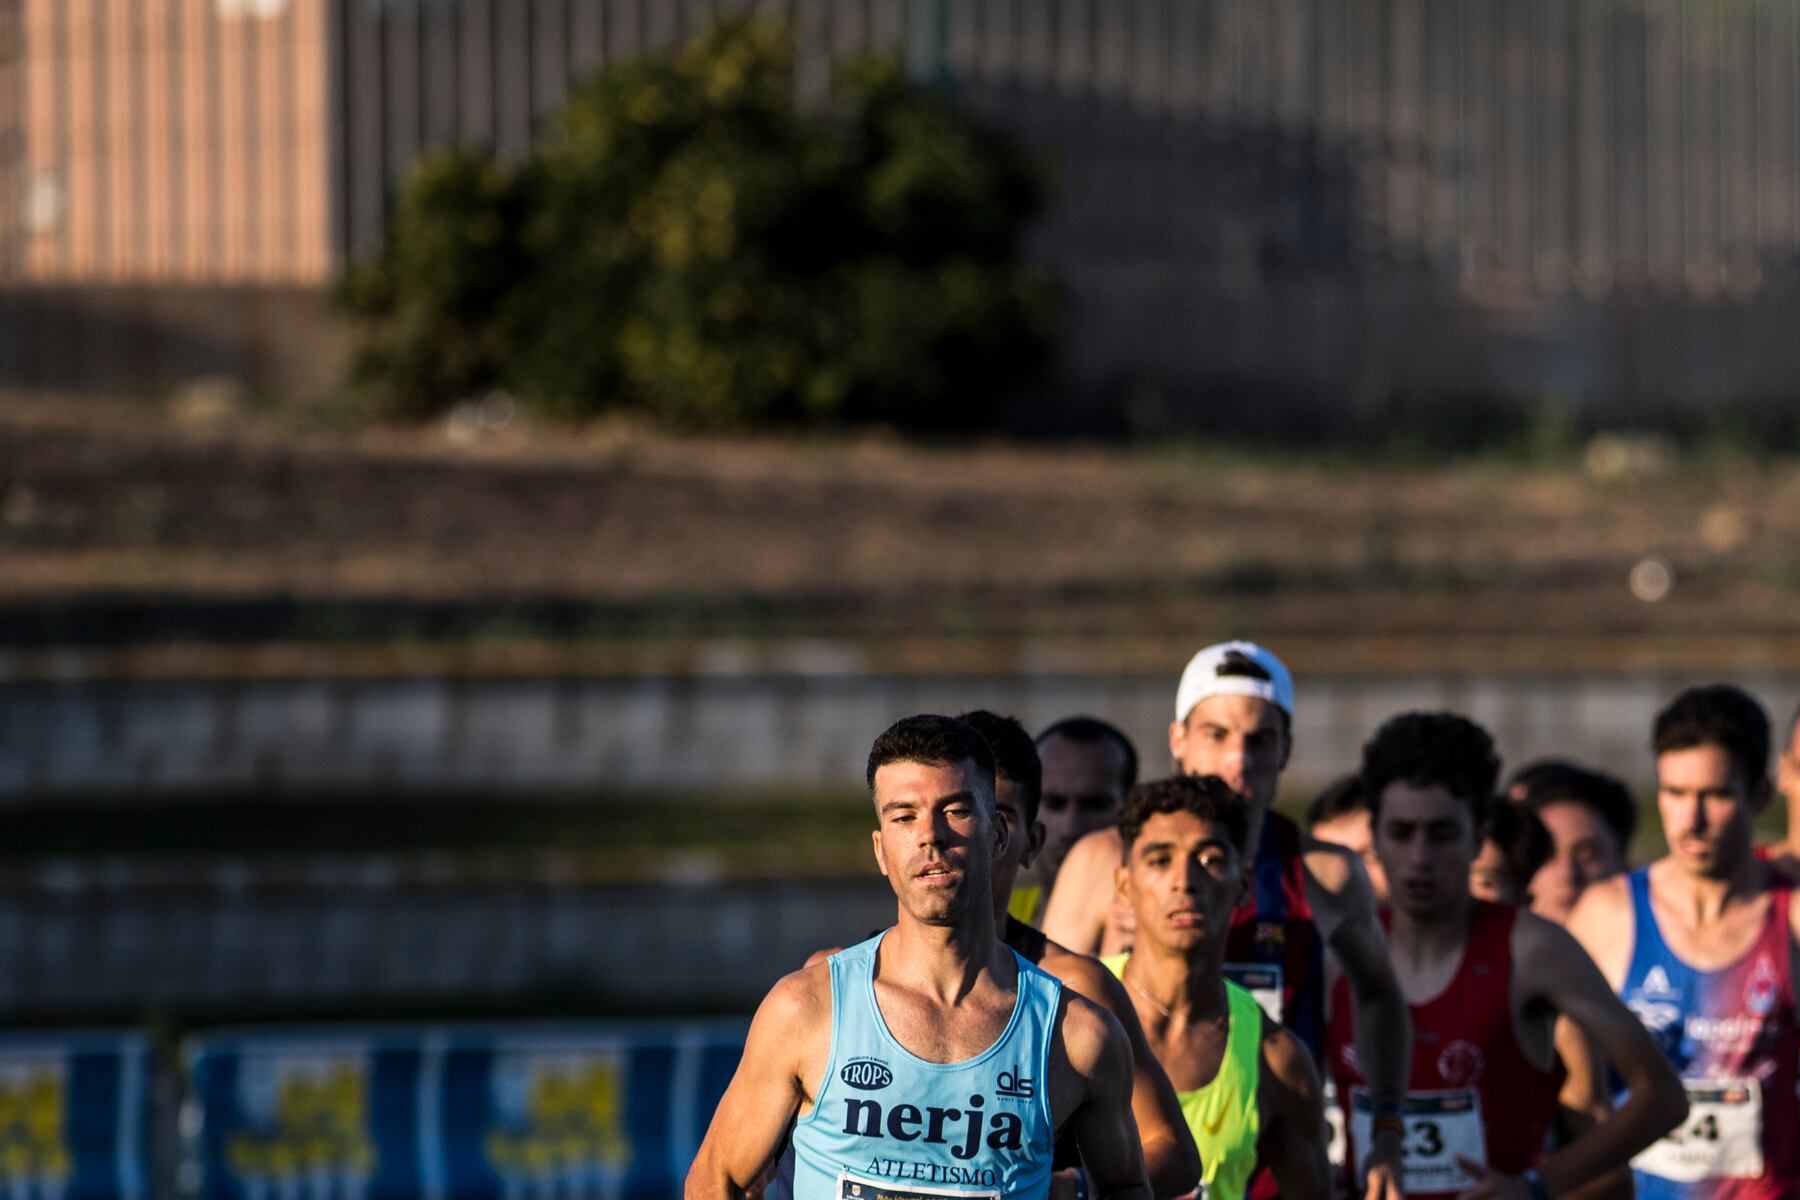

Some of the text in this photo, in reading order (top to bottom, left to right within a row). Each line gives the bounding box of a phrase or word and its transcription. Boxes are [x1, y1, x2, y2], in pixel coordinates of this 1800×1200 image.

[843, 1063, 890, 1086] TROPS
[842, 1094, 1023, 1161] nerja
[867, 1157, 996, 1187] ATLETISMO
